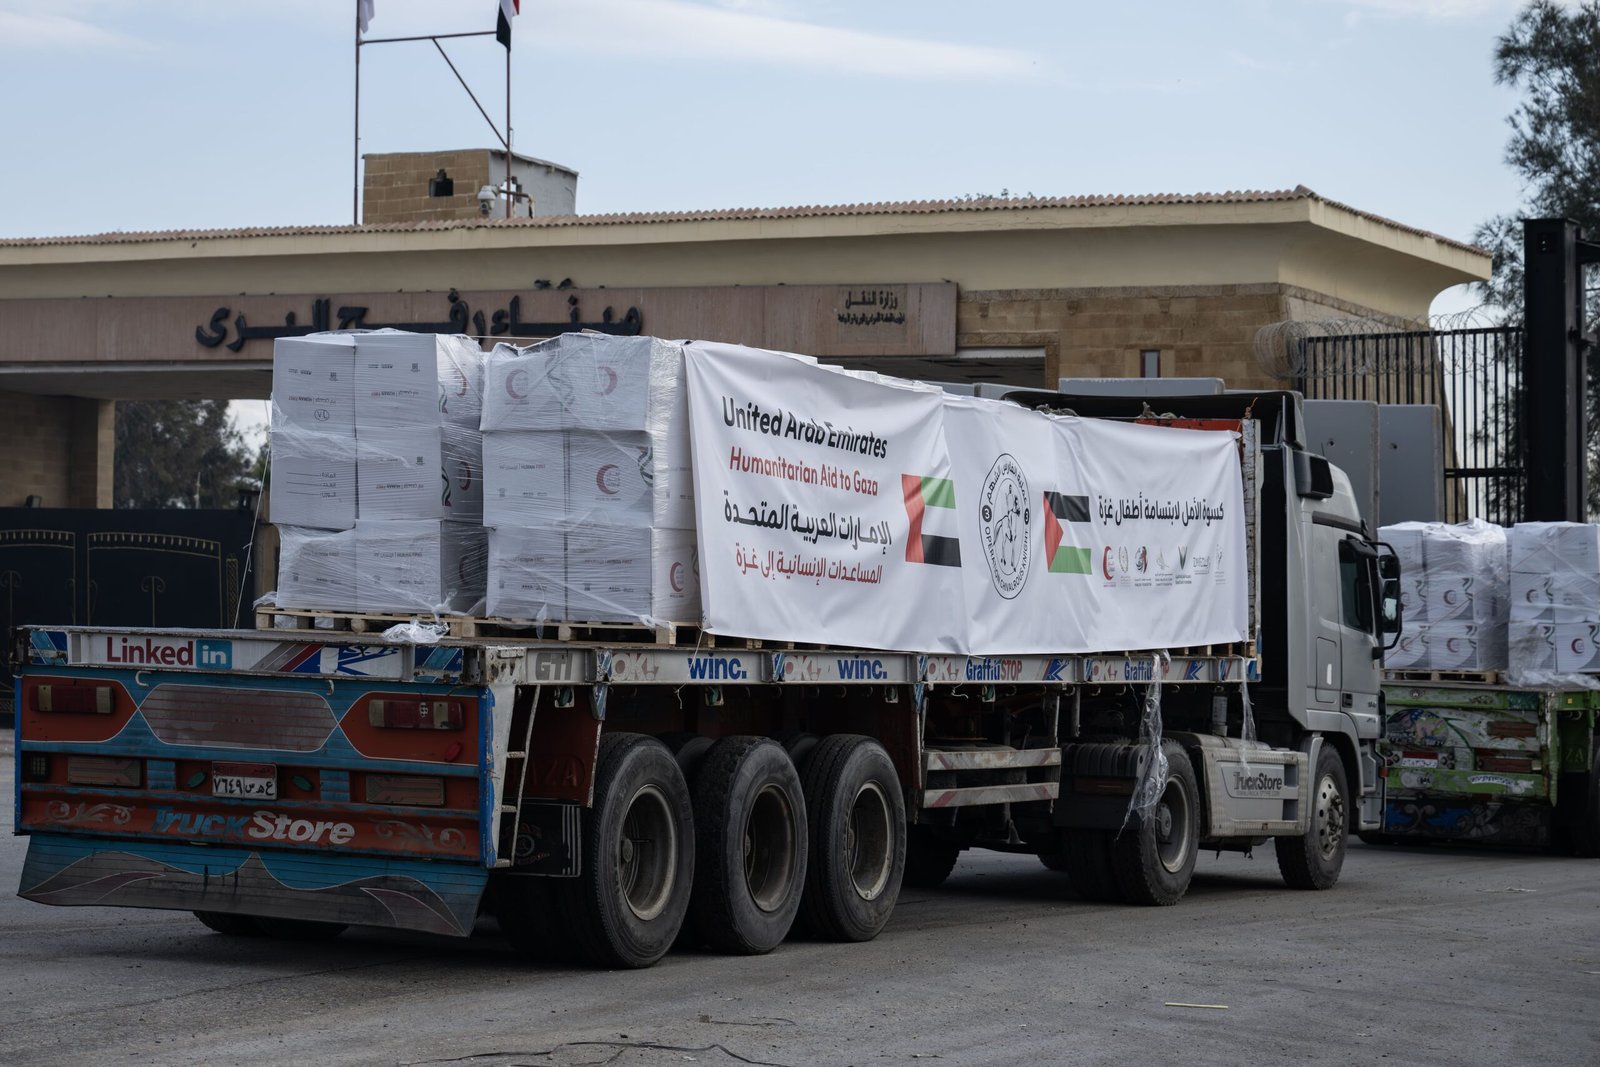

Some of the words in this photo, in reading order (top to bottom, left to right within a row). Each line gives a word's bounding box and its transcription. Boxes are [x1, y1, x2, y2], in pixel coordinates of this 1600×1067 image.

[722, 395, 783, 436] United
[784, 410, 826, 446] Arab
[823, 421, 888, 459] Emirates
[729, 445, 818, 486] Humanitarian
[820, 463, 838, 488] Aid
[840, 470, 851, 491] to
[853, 469, 879, 496] Gaza
[723, 490, 790, 530] المتحدة
[790, 504, 837, 544] العربية
[1098, 495, 1114, 526] غزة
[1114, 491, 1143, 526] أطفال
[1144, 498, 1180, 526] لابتسامة
[1181, 497, 1202, 527] الأمل
[1202, 498, 1224, 527] كسوة
[839, 515, 892, 555] الإمارات
[735, 542, 759, 575] غزة
[760, 550, 776, 580] إلى
[776, 550, 827, 586] الإنسانية
[828, 560, 883, 584] المساعدات
